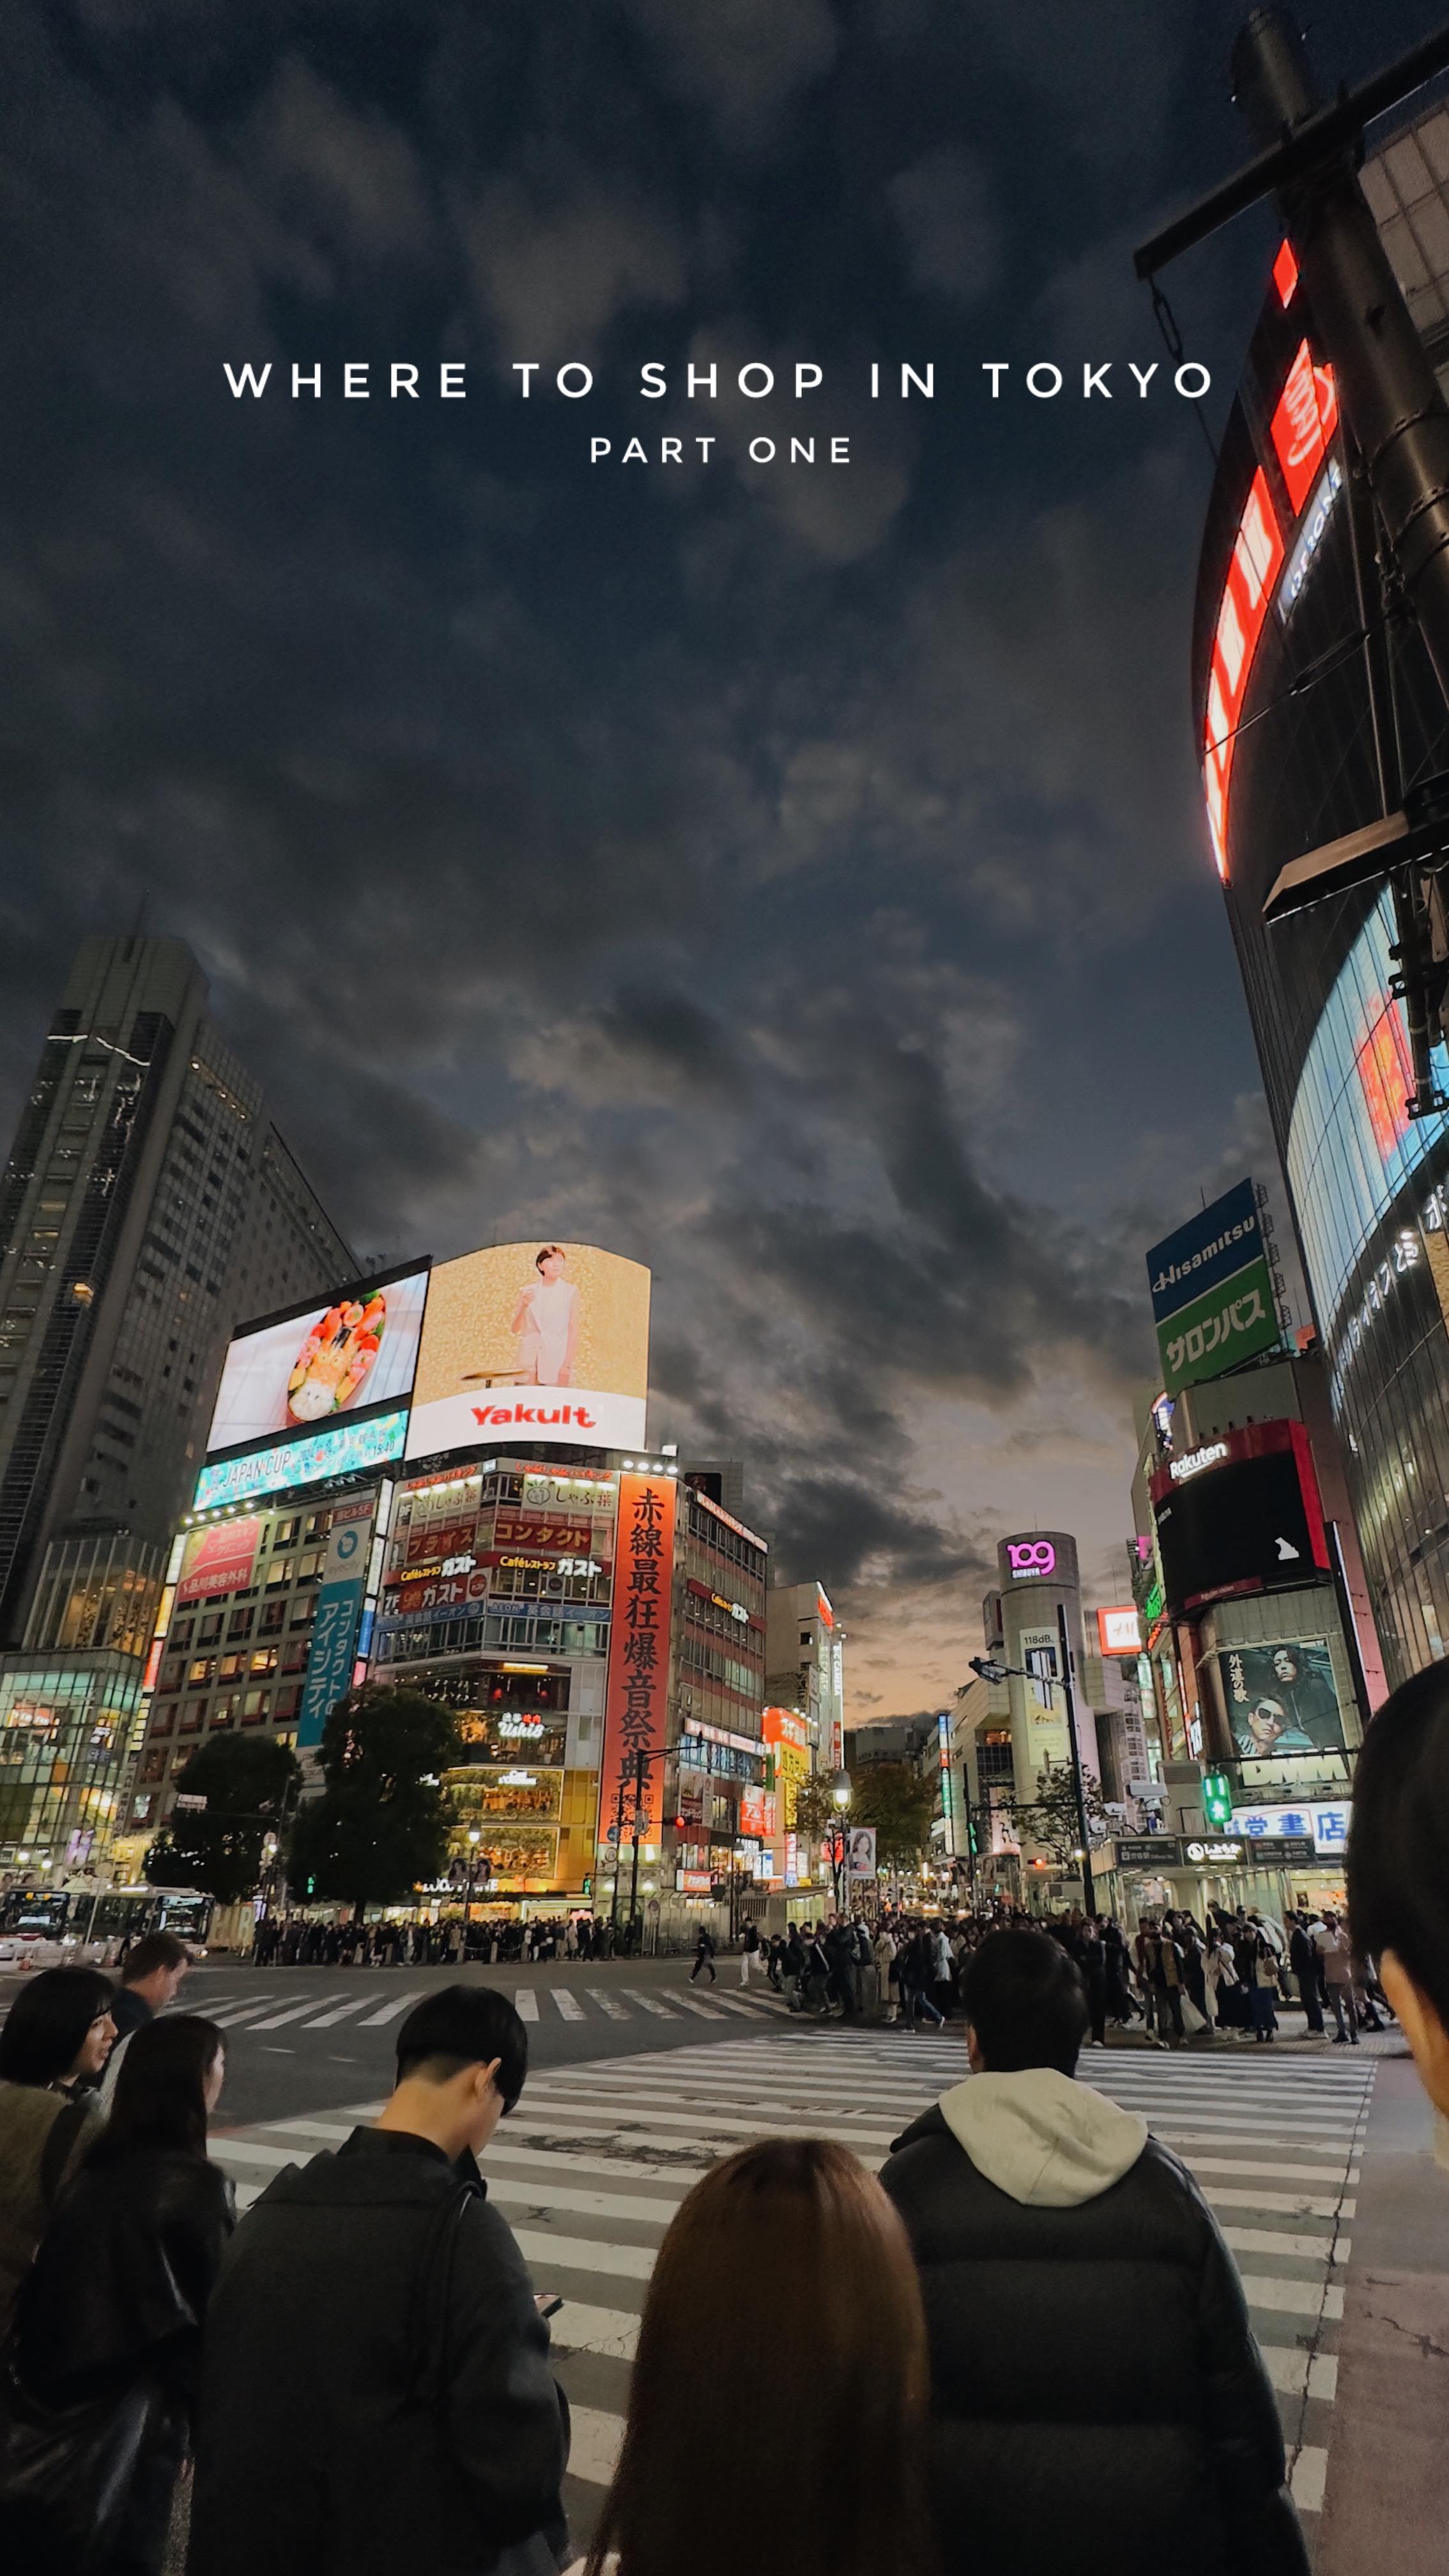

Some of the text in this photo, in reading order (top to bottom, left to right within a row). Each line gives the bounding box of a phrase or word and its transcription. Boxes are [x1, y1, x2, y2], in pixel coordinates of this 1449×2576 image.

[1153, 1216, 1255, 1294] Hisamitsu
[1166, 1289, 1266, 1373] サロンパス
[470, 1404, 597, 1429] Yakult
[222, 1459, 263, 1488] JAPAN
[265, 1451, 292, 1476] CUP
[1169, 1442, 1228, 1480] Rakuten
[556, 1487, 611, 1506] しゃぶ葉
[496, 1523, 589, 1549] コンタクト
[441, 1555, 477, 1577] ガスト
[557, 1558, 602, 1577] ガスト
[1007, 1540, 1055, 1575] 109
[188, 1568, 248, 1593] 品川美容外科
[385, 1595, 401, 1609] 7F
[422, 1583, 464, 1608] ガスト
[527, 1604, 610, 1621] 英会話イーオン
[616, 1489, 665, 1790] 赤線最狂爆音祭典
[308, 1602, 340, 1719] アイシティ
[1229, 1653, 1250, 1703] 外道の歌
